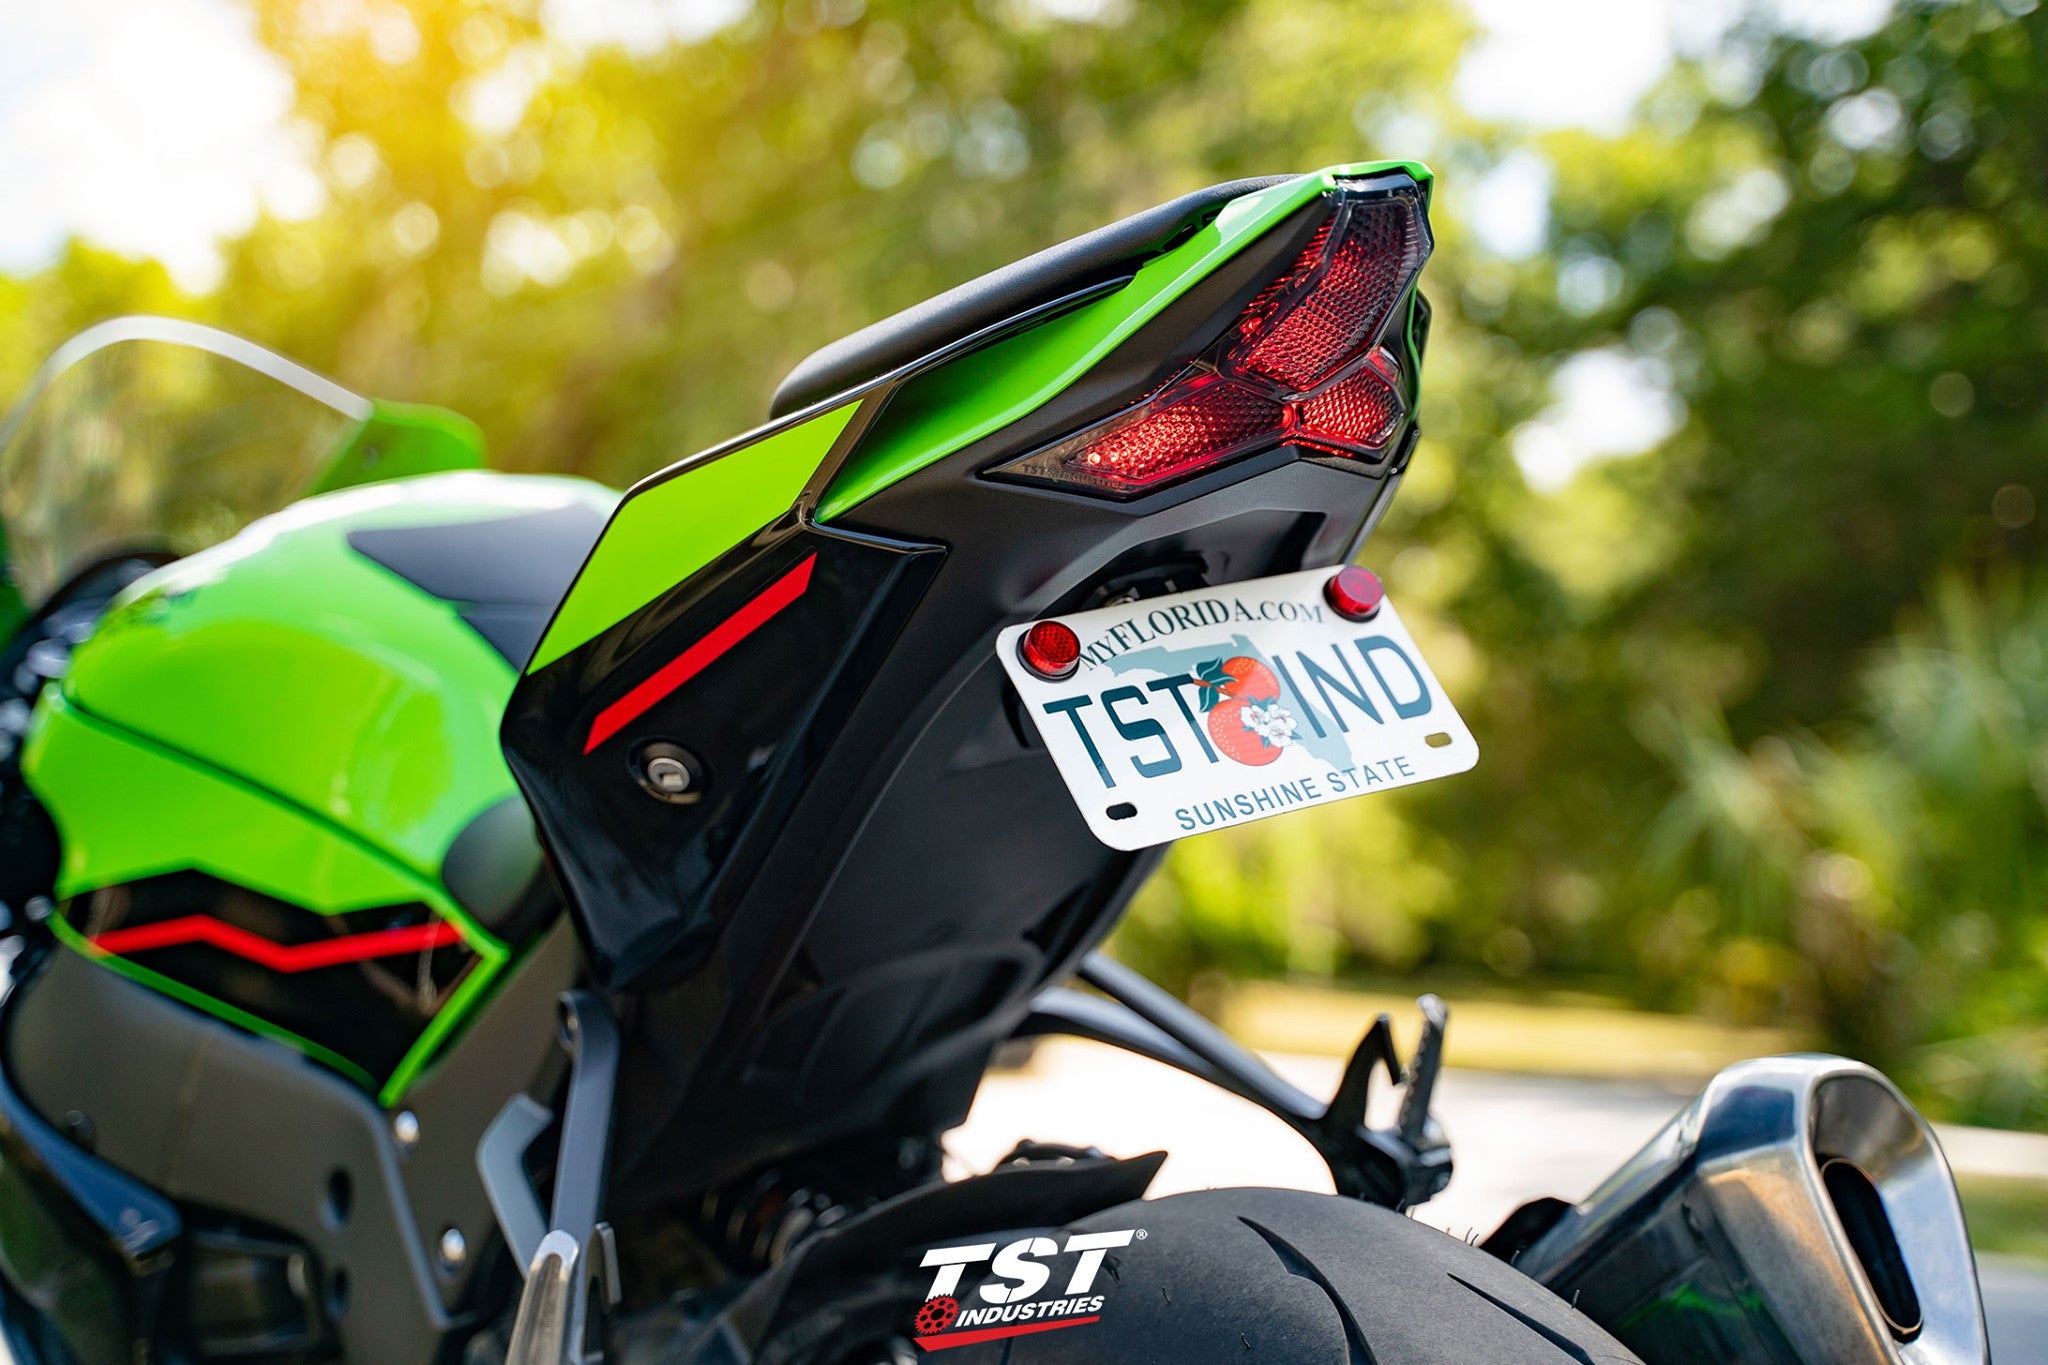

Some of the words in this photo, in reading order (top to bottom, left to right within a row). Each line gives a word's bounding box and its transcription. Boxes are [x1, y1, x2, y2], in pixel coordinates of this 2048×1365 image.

[1043, 673, 1219, 789] TST
[1271, 634, 1433, 739] IND
[1174, 777, 1323, 831] SUNSHINE
[1331, 756, 1417, 793] STATE
